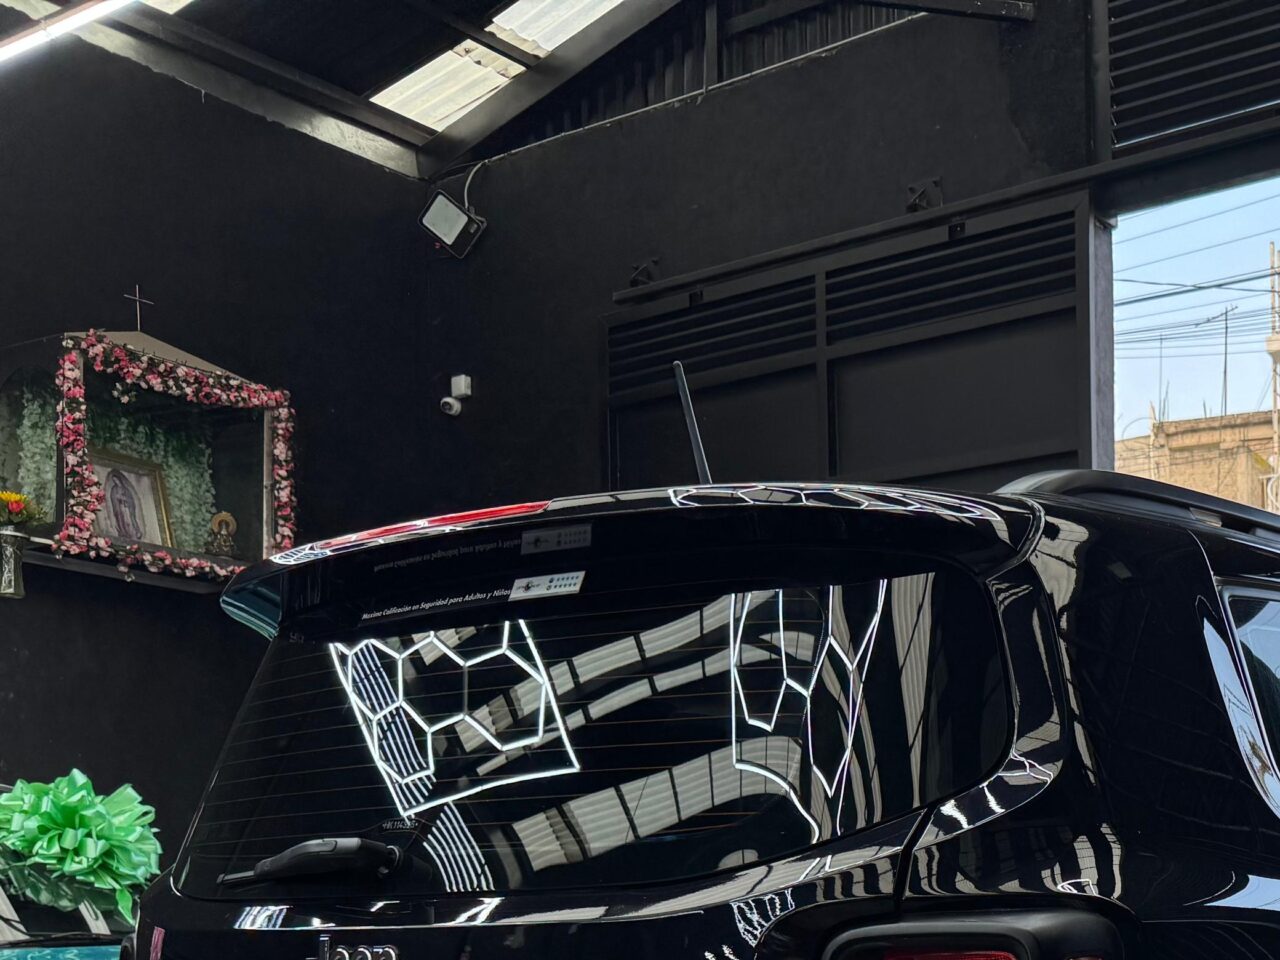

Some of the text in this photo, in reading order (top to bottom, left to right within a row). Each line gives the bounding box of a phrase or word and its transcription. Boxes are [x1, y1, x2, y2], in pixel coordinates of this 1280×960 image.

[420, 597, 449, 610] Seguridad
[448, 597, 463, 605] para
[463, 592, 486, 602] Adultos
